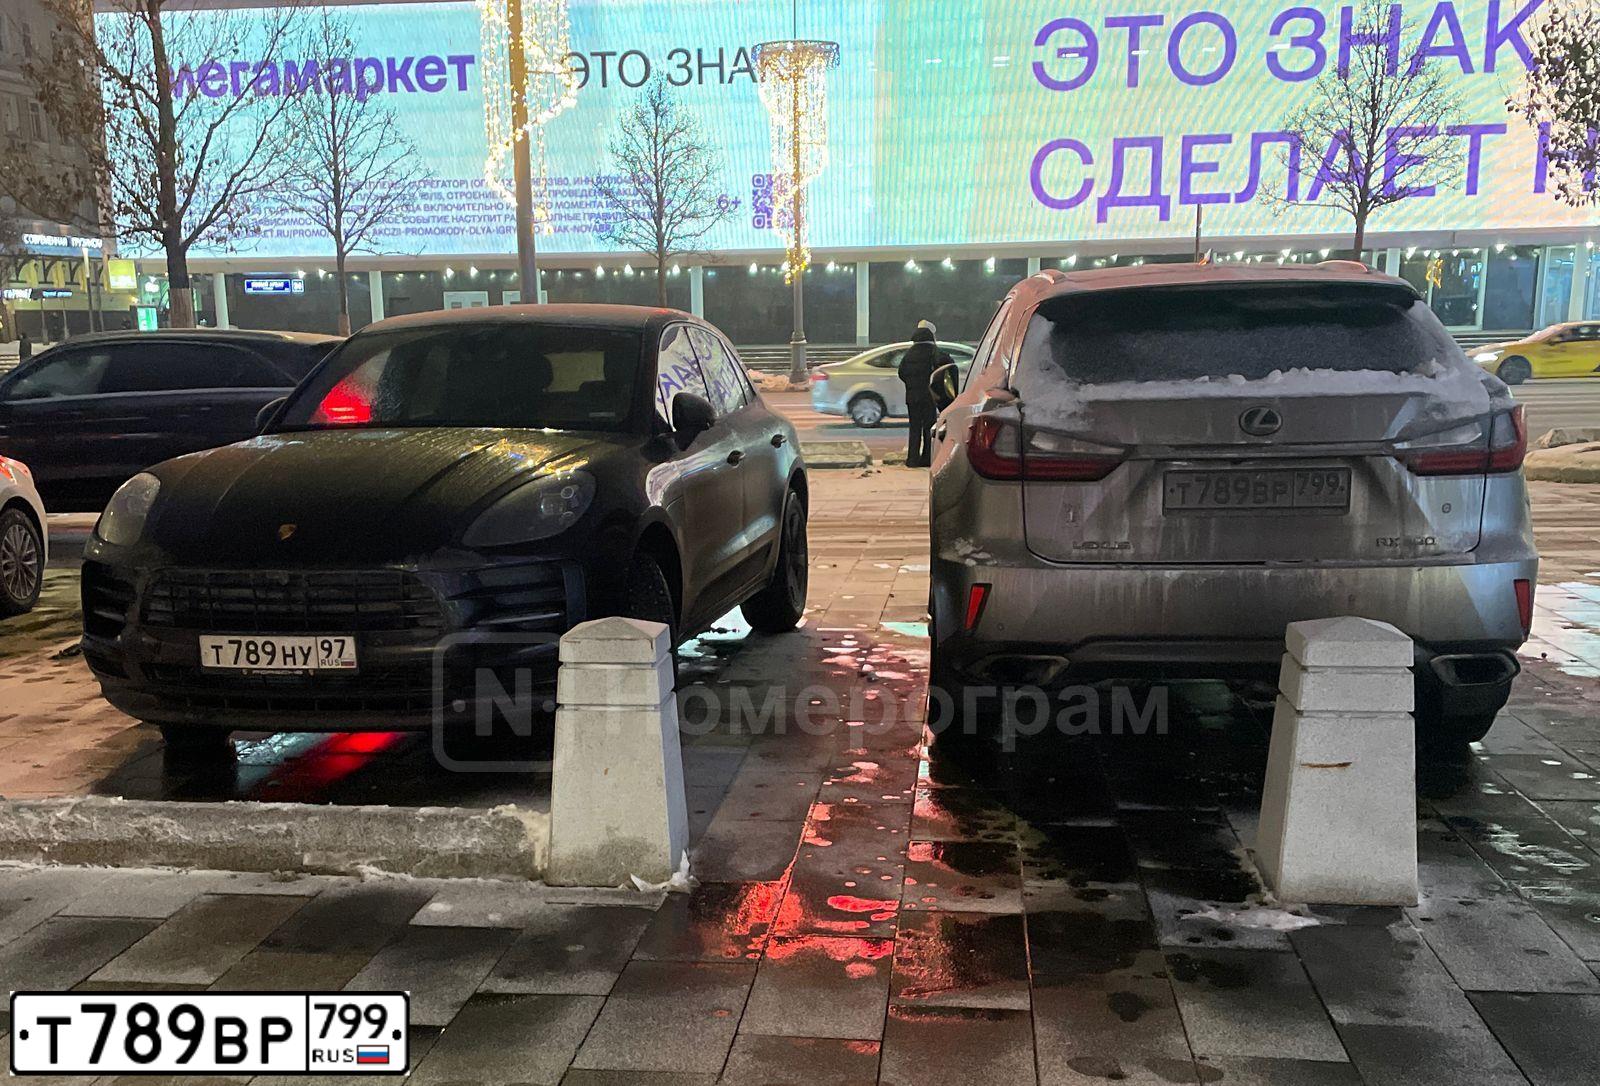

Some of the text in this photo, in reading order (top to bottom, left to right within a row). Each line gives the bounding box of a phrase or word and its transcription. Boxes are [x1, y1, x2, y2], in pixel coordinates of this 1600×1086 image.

[1032, 0, 1545, 91] ЭТО ЗНАК
[563, 46, 766, 89] ЭТО ЗНА
[1029, 122, 1507, 223] СДЕЛАЕТ
[423, 202, 504, 212] ВКЛЮЧИТЕЛЬНО
[555, 200, 604, 210] МОМЕНТА
[716, 193, 742, 212] 6+
[403, 215, 450, 224] СОБЫТИЕ
[452, 213, 503, 223] НАСТУПИТ
[1175, 471, 1340, 505] Т789ВР 799
[210, 638, 346, 667] Т789НУ 97
[320, 658, 341, 667] RUS
